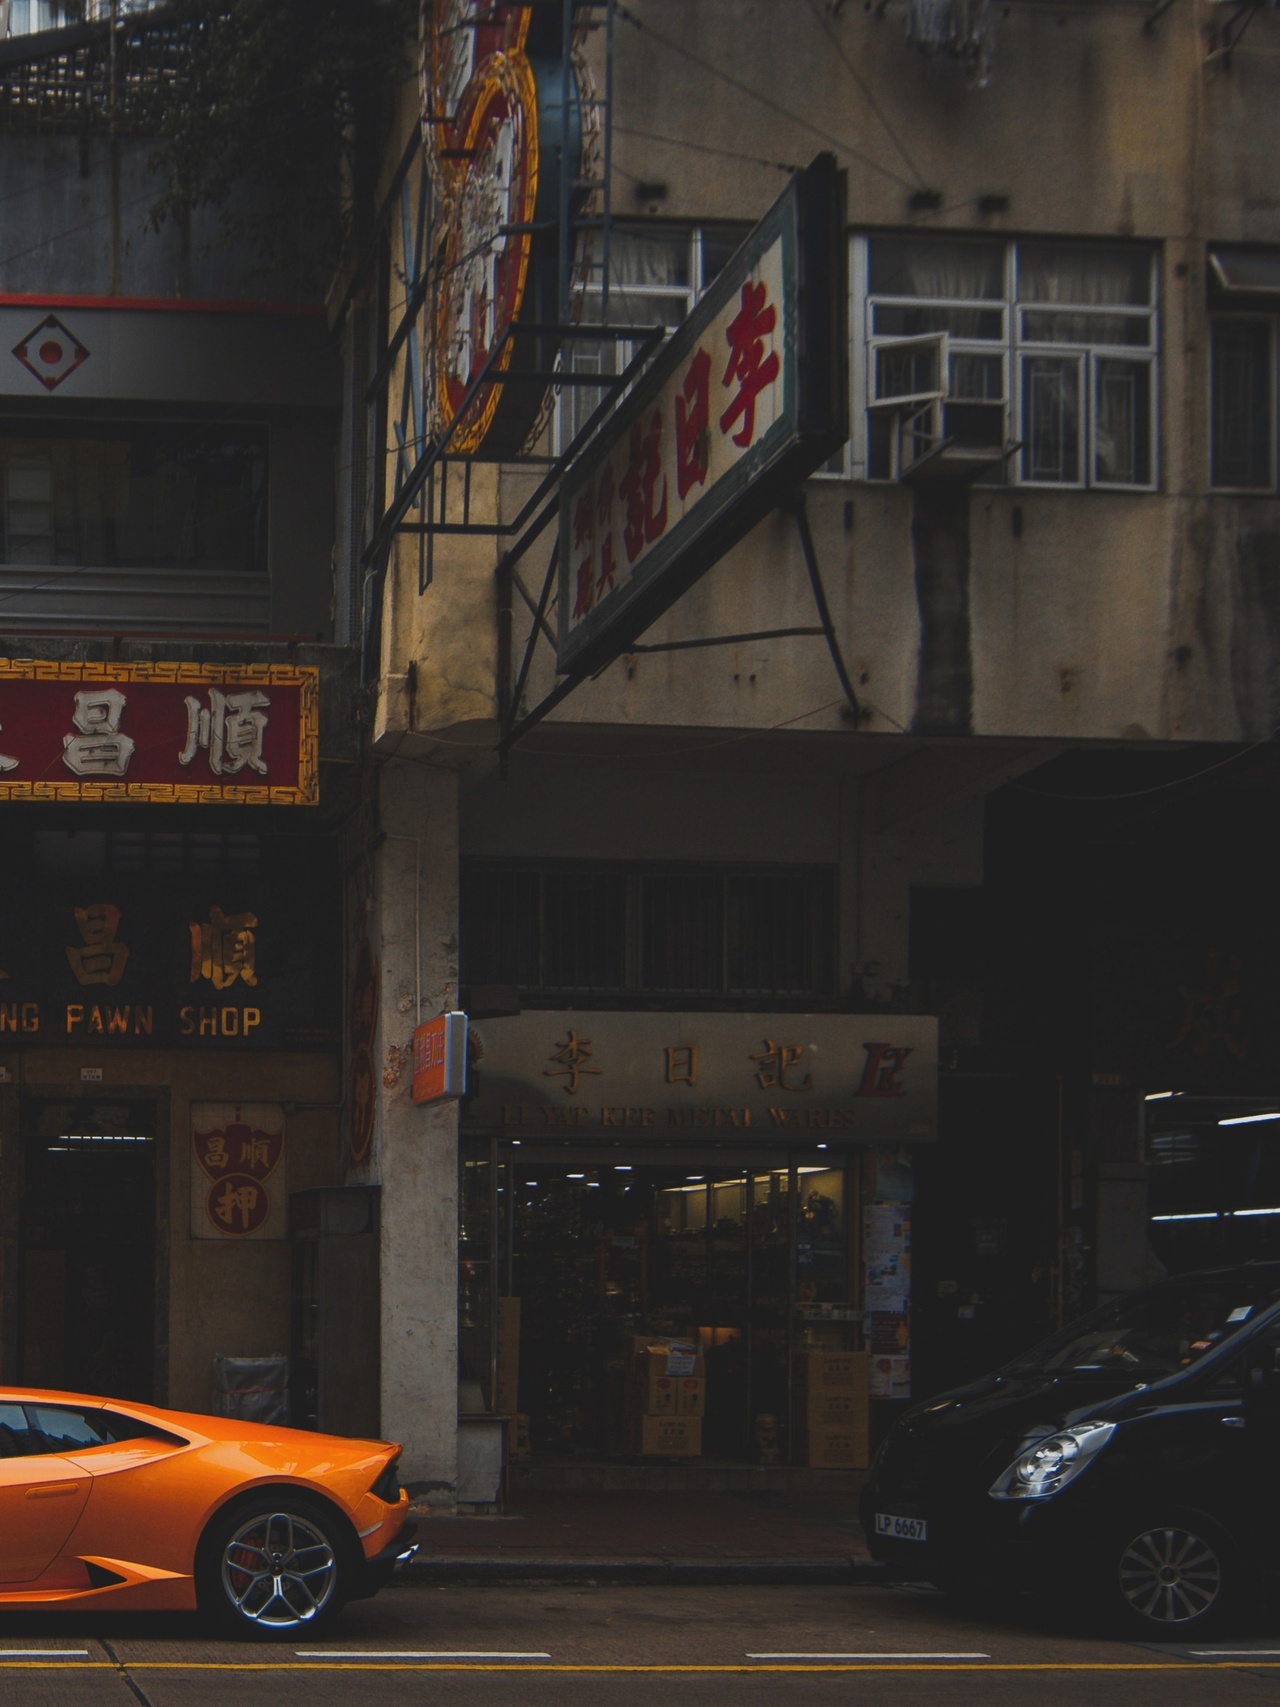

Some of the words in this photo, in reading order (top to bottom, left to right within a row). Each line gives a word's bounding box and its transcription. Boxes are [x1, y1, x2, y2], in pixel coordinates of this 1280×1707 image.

[66, 1003, 154, 1036] PAWN
[180, 1005, 261, 1038] SHOP
[543, 1029, 814, 1096] 李日記
[501, 1104, 529, 1127] LI
[541, 1106, 590, 1127] YAT
[600, 1106, 657, 1128] KEE
[667, 1106, 759, 1129] METAL
[769, 1107, 858, 1130] WARES
[214, 1182, 260, 1230] 押
[877, 1515, 891, 1532] LP
[895, 1518, 924, 1538] 6667
